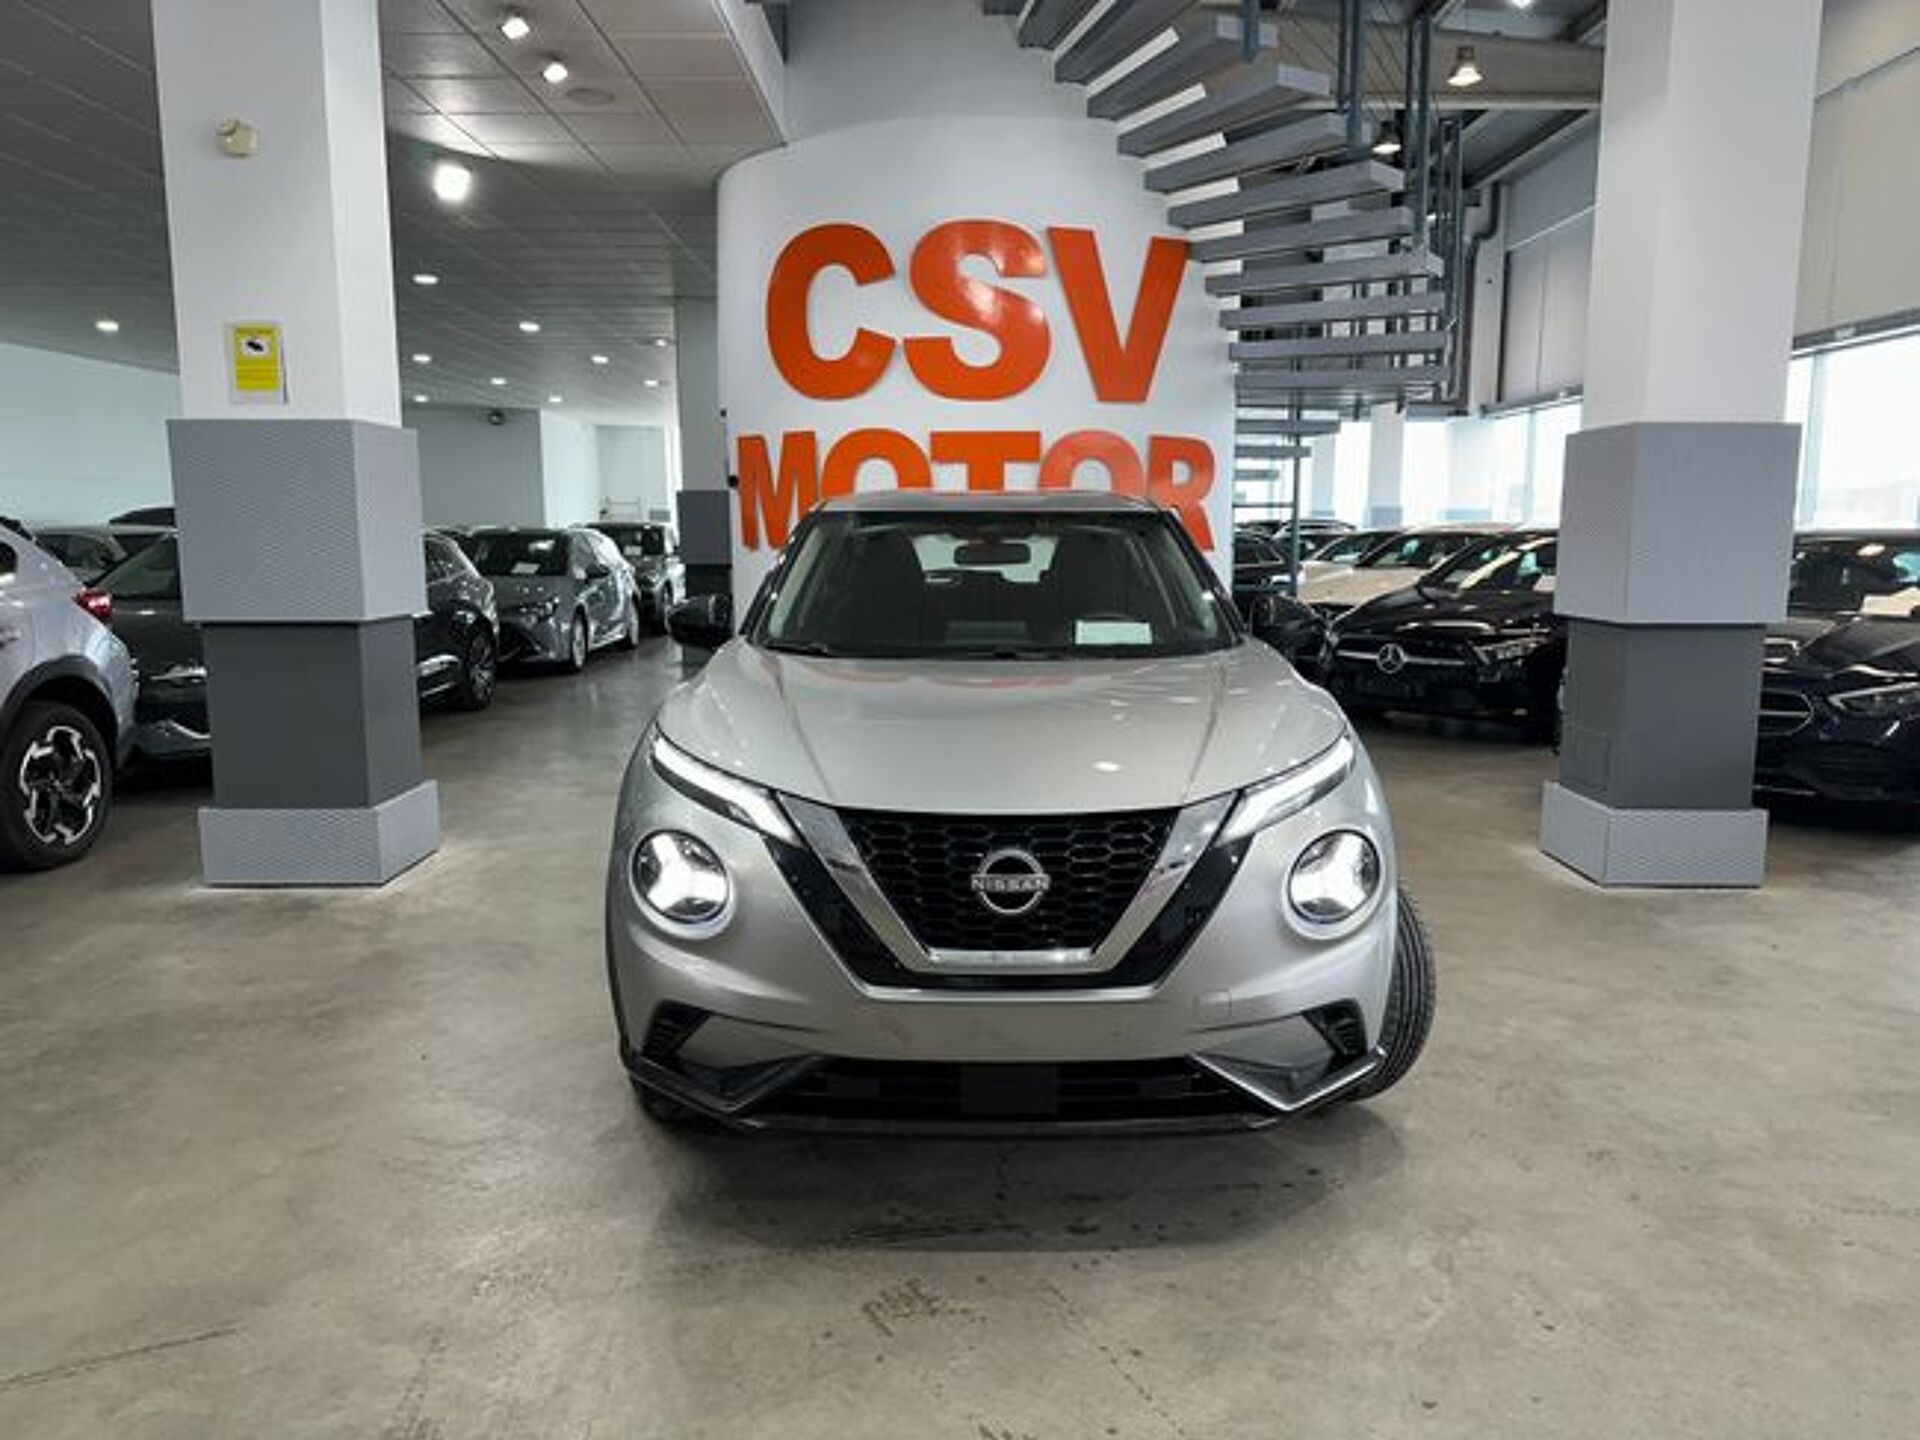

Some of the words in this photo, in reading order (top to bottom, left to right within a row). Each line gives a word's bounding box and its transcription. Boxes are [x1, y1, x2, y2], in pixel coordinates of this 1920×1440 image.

[766, 219, 1192, 403] CSV
[737, 428, 1215, 551] MOTOR
[971, 873, 1050, 891] NISSAN
